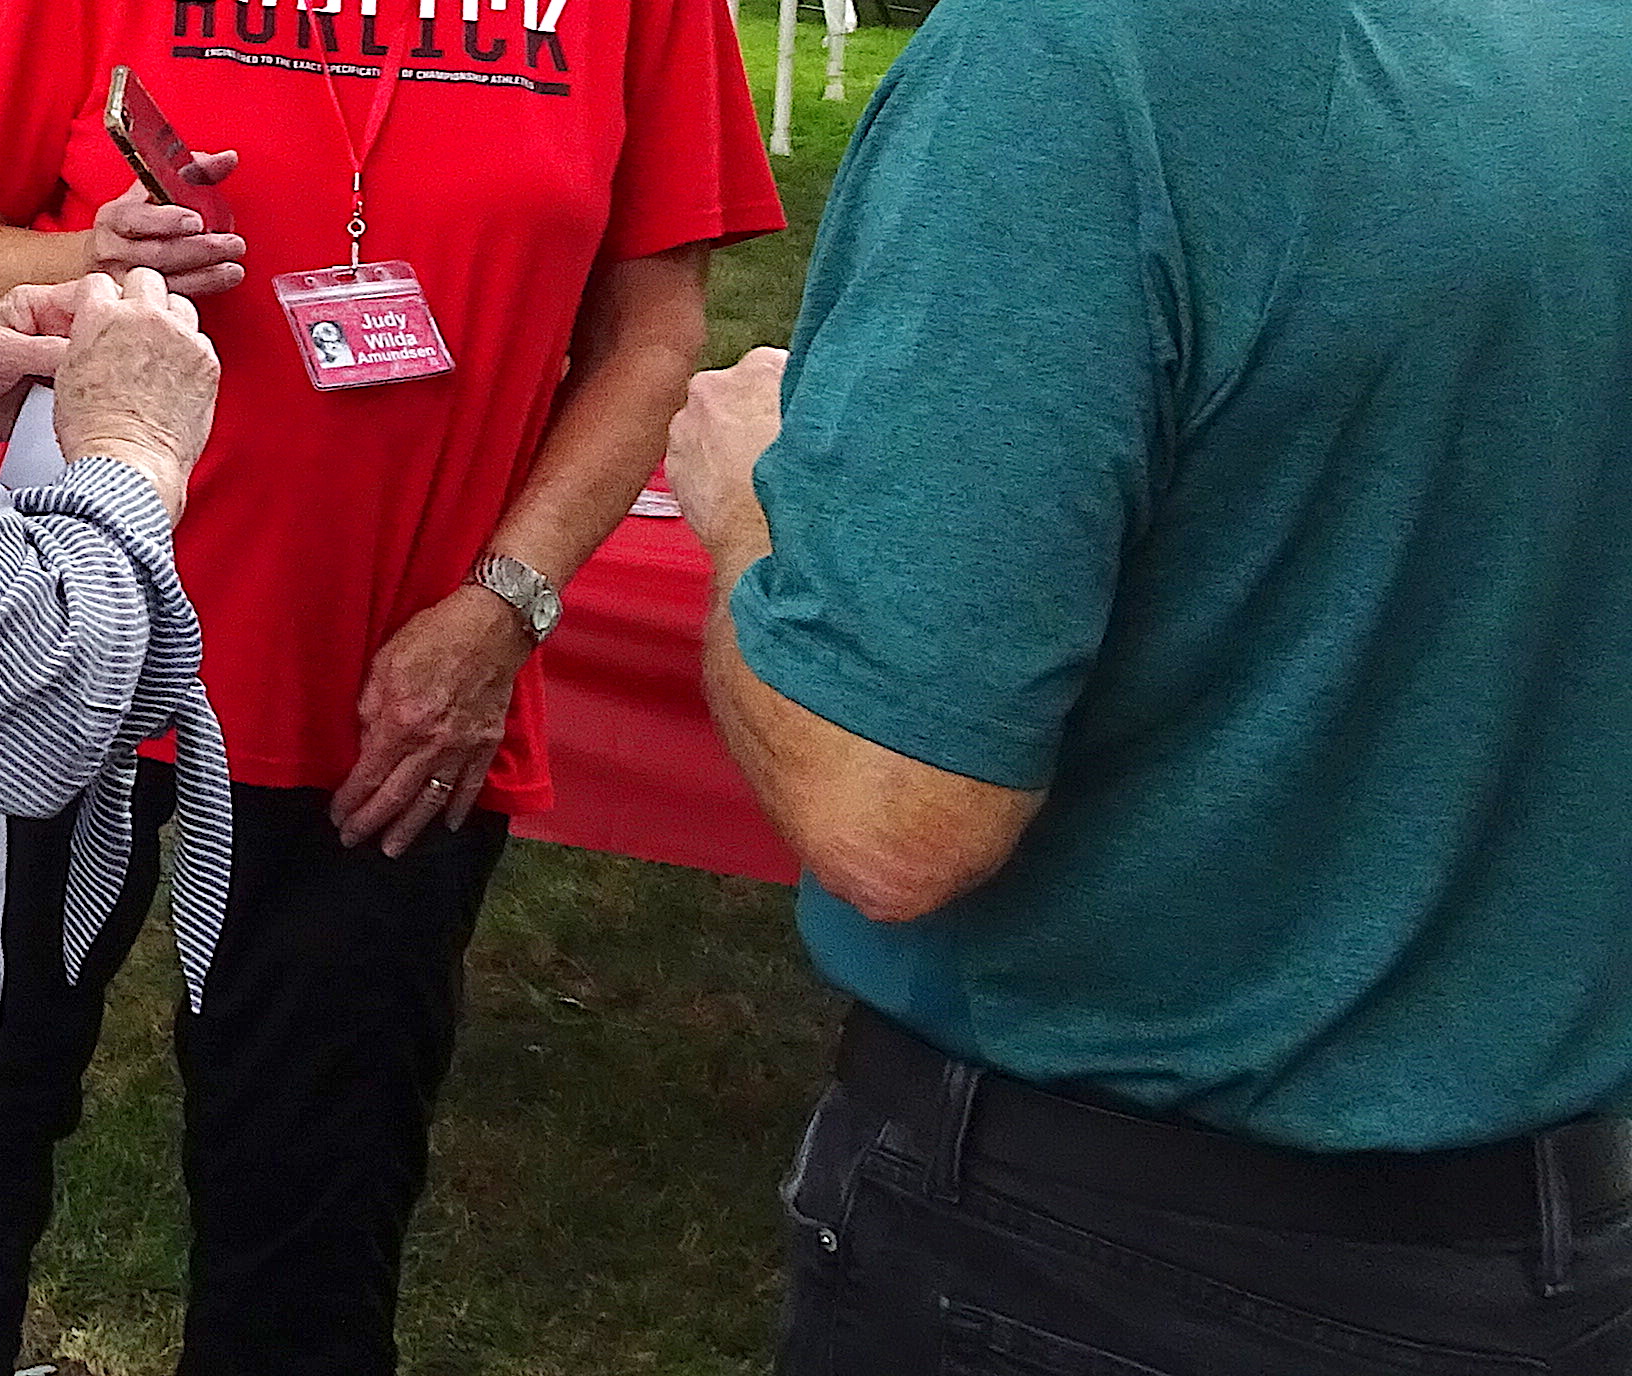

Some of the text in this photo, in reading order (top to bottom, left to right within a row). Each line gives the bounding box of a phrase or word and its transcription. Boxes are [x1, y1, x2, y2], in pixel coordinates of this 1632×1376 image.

[260, 55, 274, 64] TO
[275, 56, 291, 68] THE
[293, 60, 322, 72] EXACT
[401, 69, 414, 78] OF
[416, 70, 489, 83] CHAMPIONSHIP
[362, 311, 406, 330] Judy
[364, 331, 418, 350] Wilda
[357, 347, 436, 364] Amundsen
